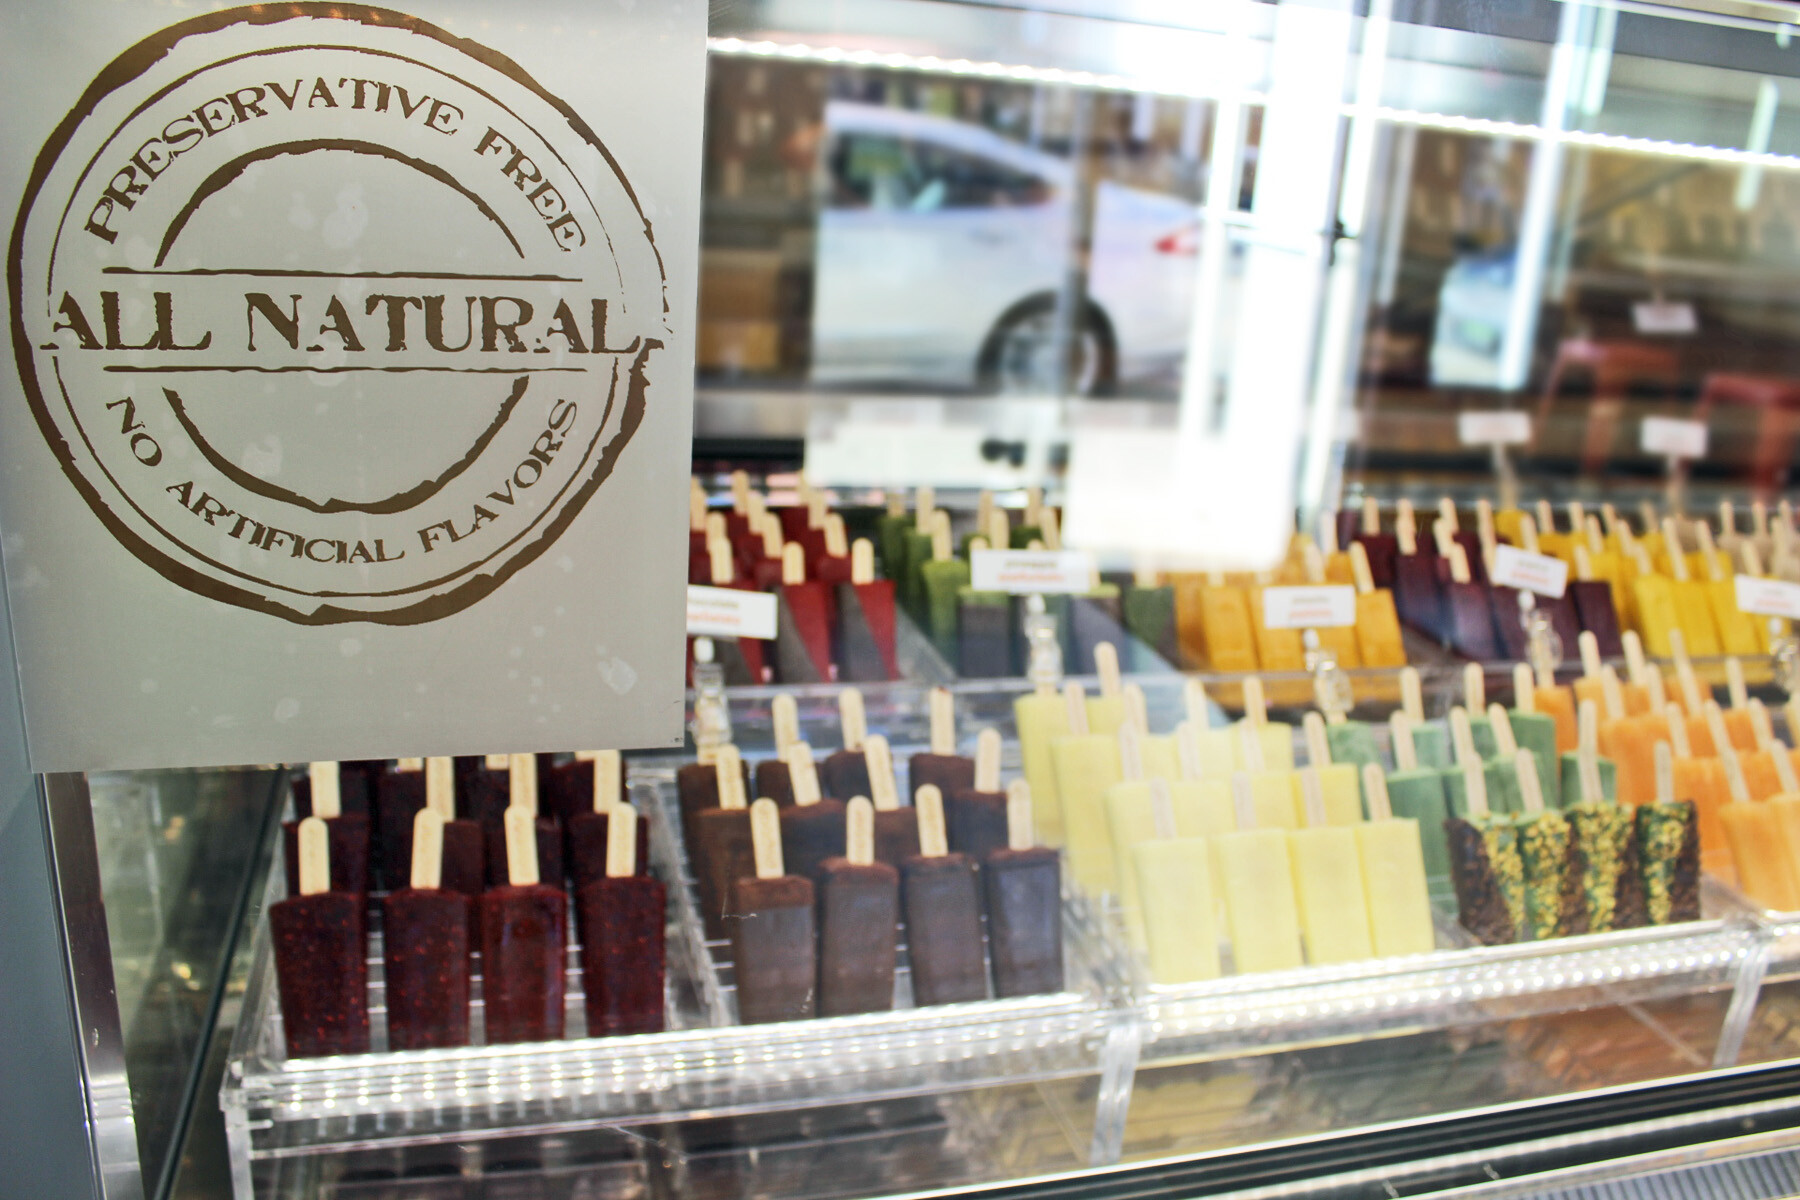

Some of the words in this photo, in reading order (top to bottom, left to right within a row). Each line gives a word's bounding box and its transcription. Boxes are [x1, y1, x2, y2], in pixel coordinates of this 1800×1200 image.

[84, 77, 464, 245] PRESERVATIVE
[474, 126, 587, 253] FREE
[40, 291, 212, 352] ALL
[245, 293, 641, 354] NATURAL
[106, 397, 163, 467] NO
[166, 480, 406, 564] ARTIFICIAL
[417, 398, 578, 554] FLAVORS
